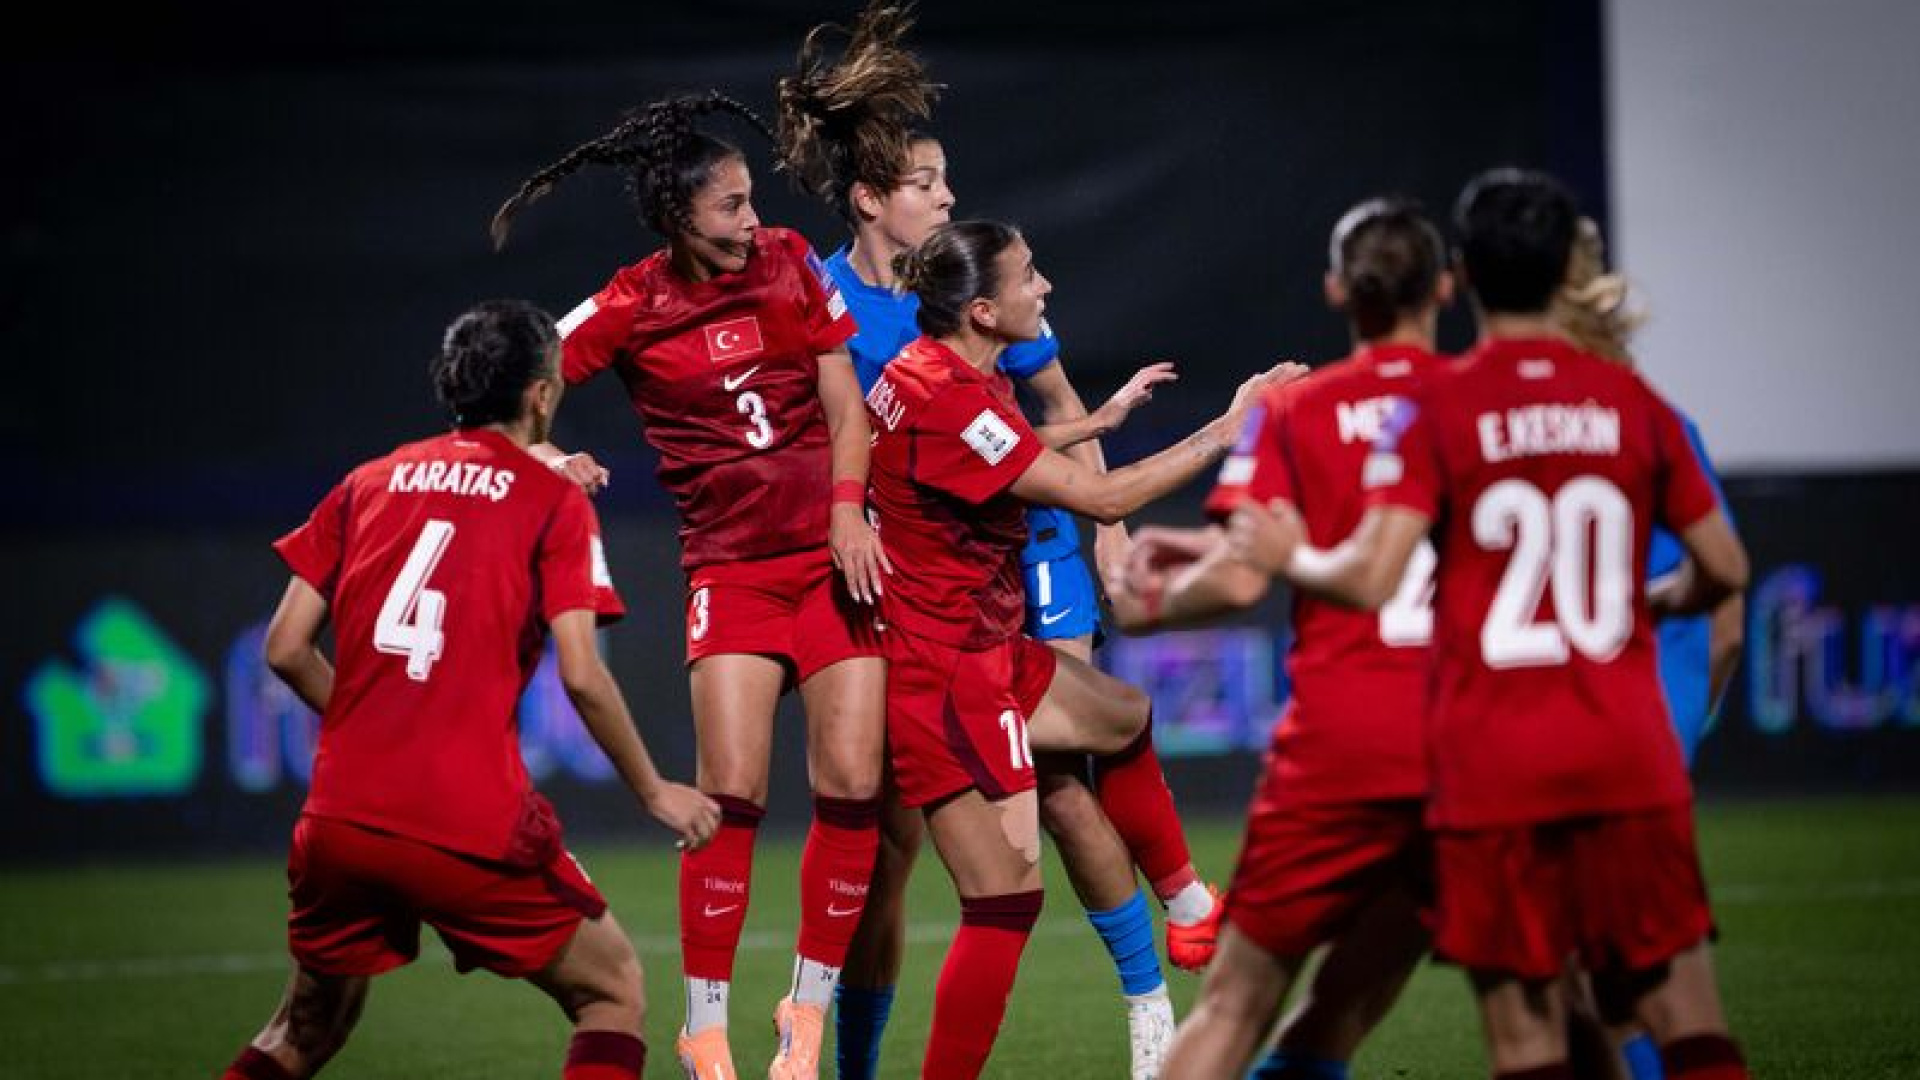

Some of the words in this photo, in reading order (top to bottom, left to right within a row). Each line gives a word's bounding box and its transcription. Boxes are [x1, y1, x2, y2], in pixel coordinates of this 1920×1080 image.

[736, 391, 774, 449] 3
[373, 518, 456, 682] 4
[690, 587, 710, 640] 3
[1472, 475, 1635, 668] 20
